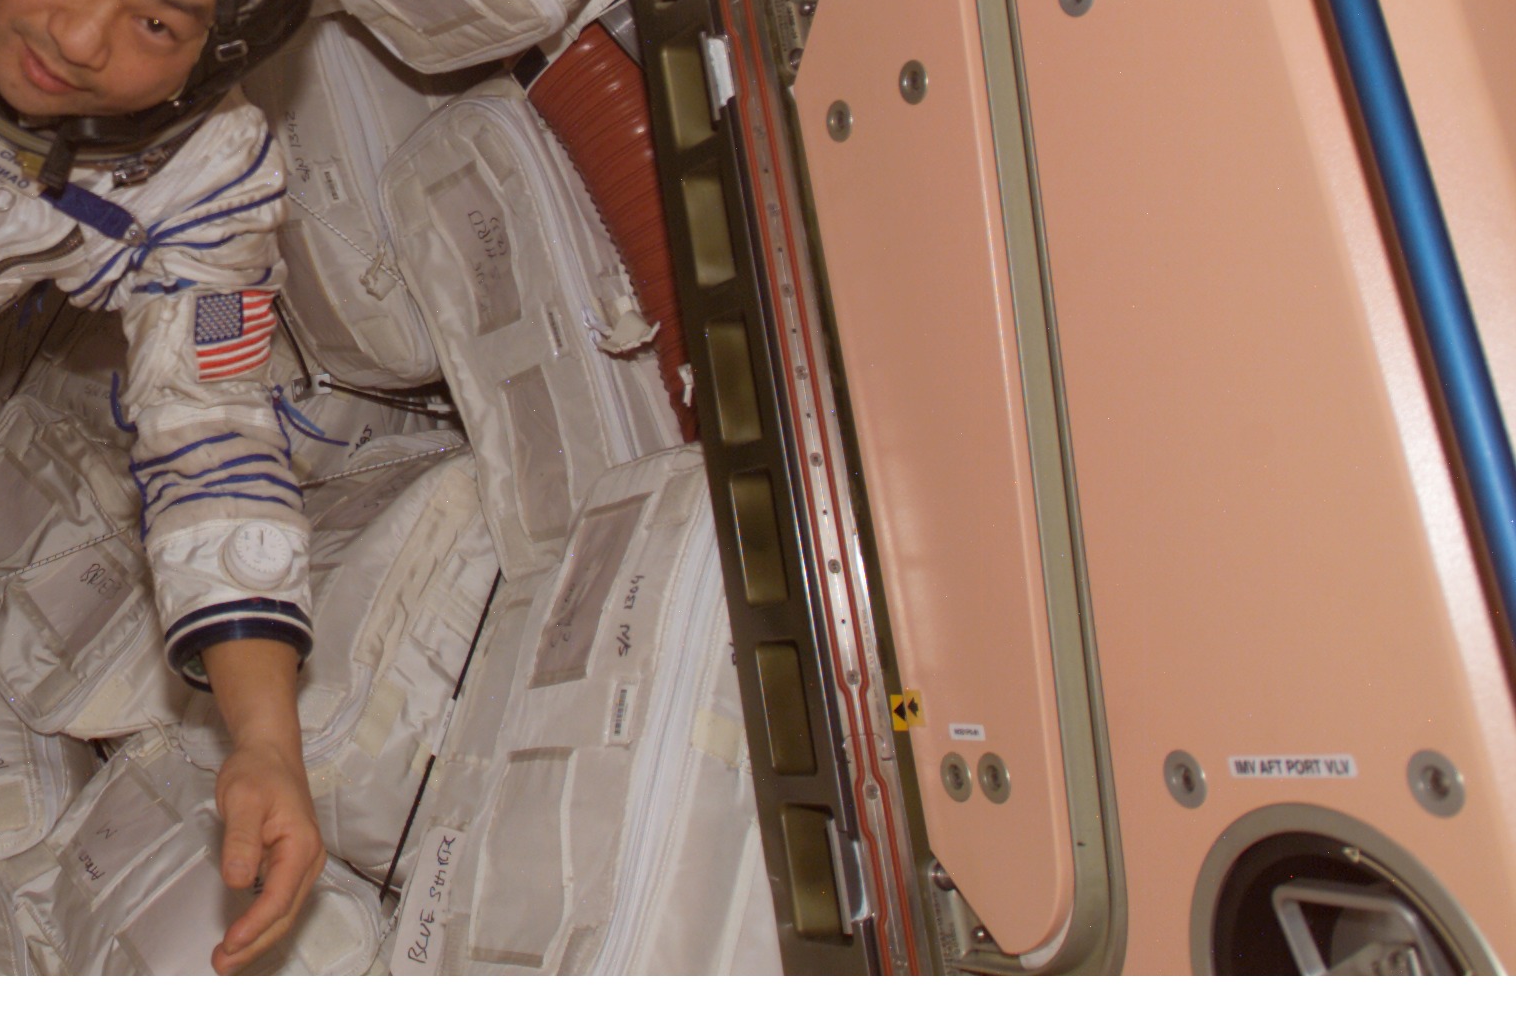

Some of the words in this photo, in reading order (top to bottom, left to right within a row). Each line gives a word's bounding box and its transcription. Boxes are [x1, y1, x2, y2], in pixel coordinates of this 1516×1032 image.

[623, 575, 645, 609] 1304
[616, 624, 631, 657] S/N
[1234, 759, 1255, 775] IMV
[1259, 759, 1282, 775] AFT
[1285, 759, 1322, 775] PORT
[1325, 760, 1351, 776] VLV
[408, 909, 434, 964] BLUE
